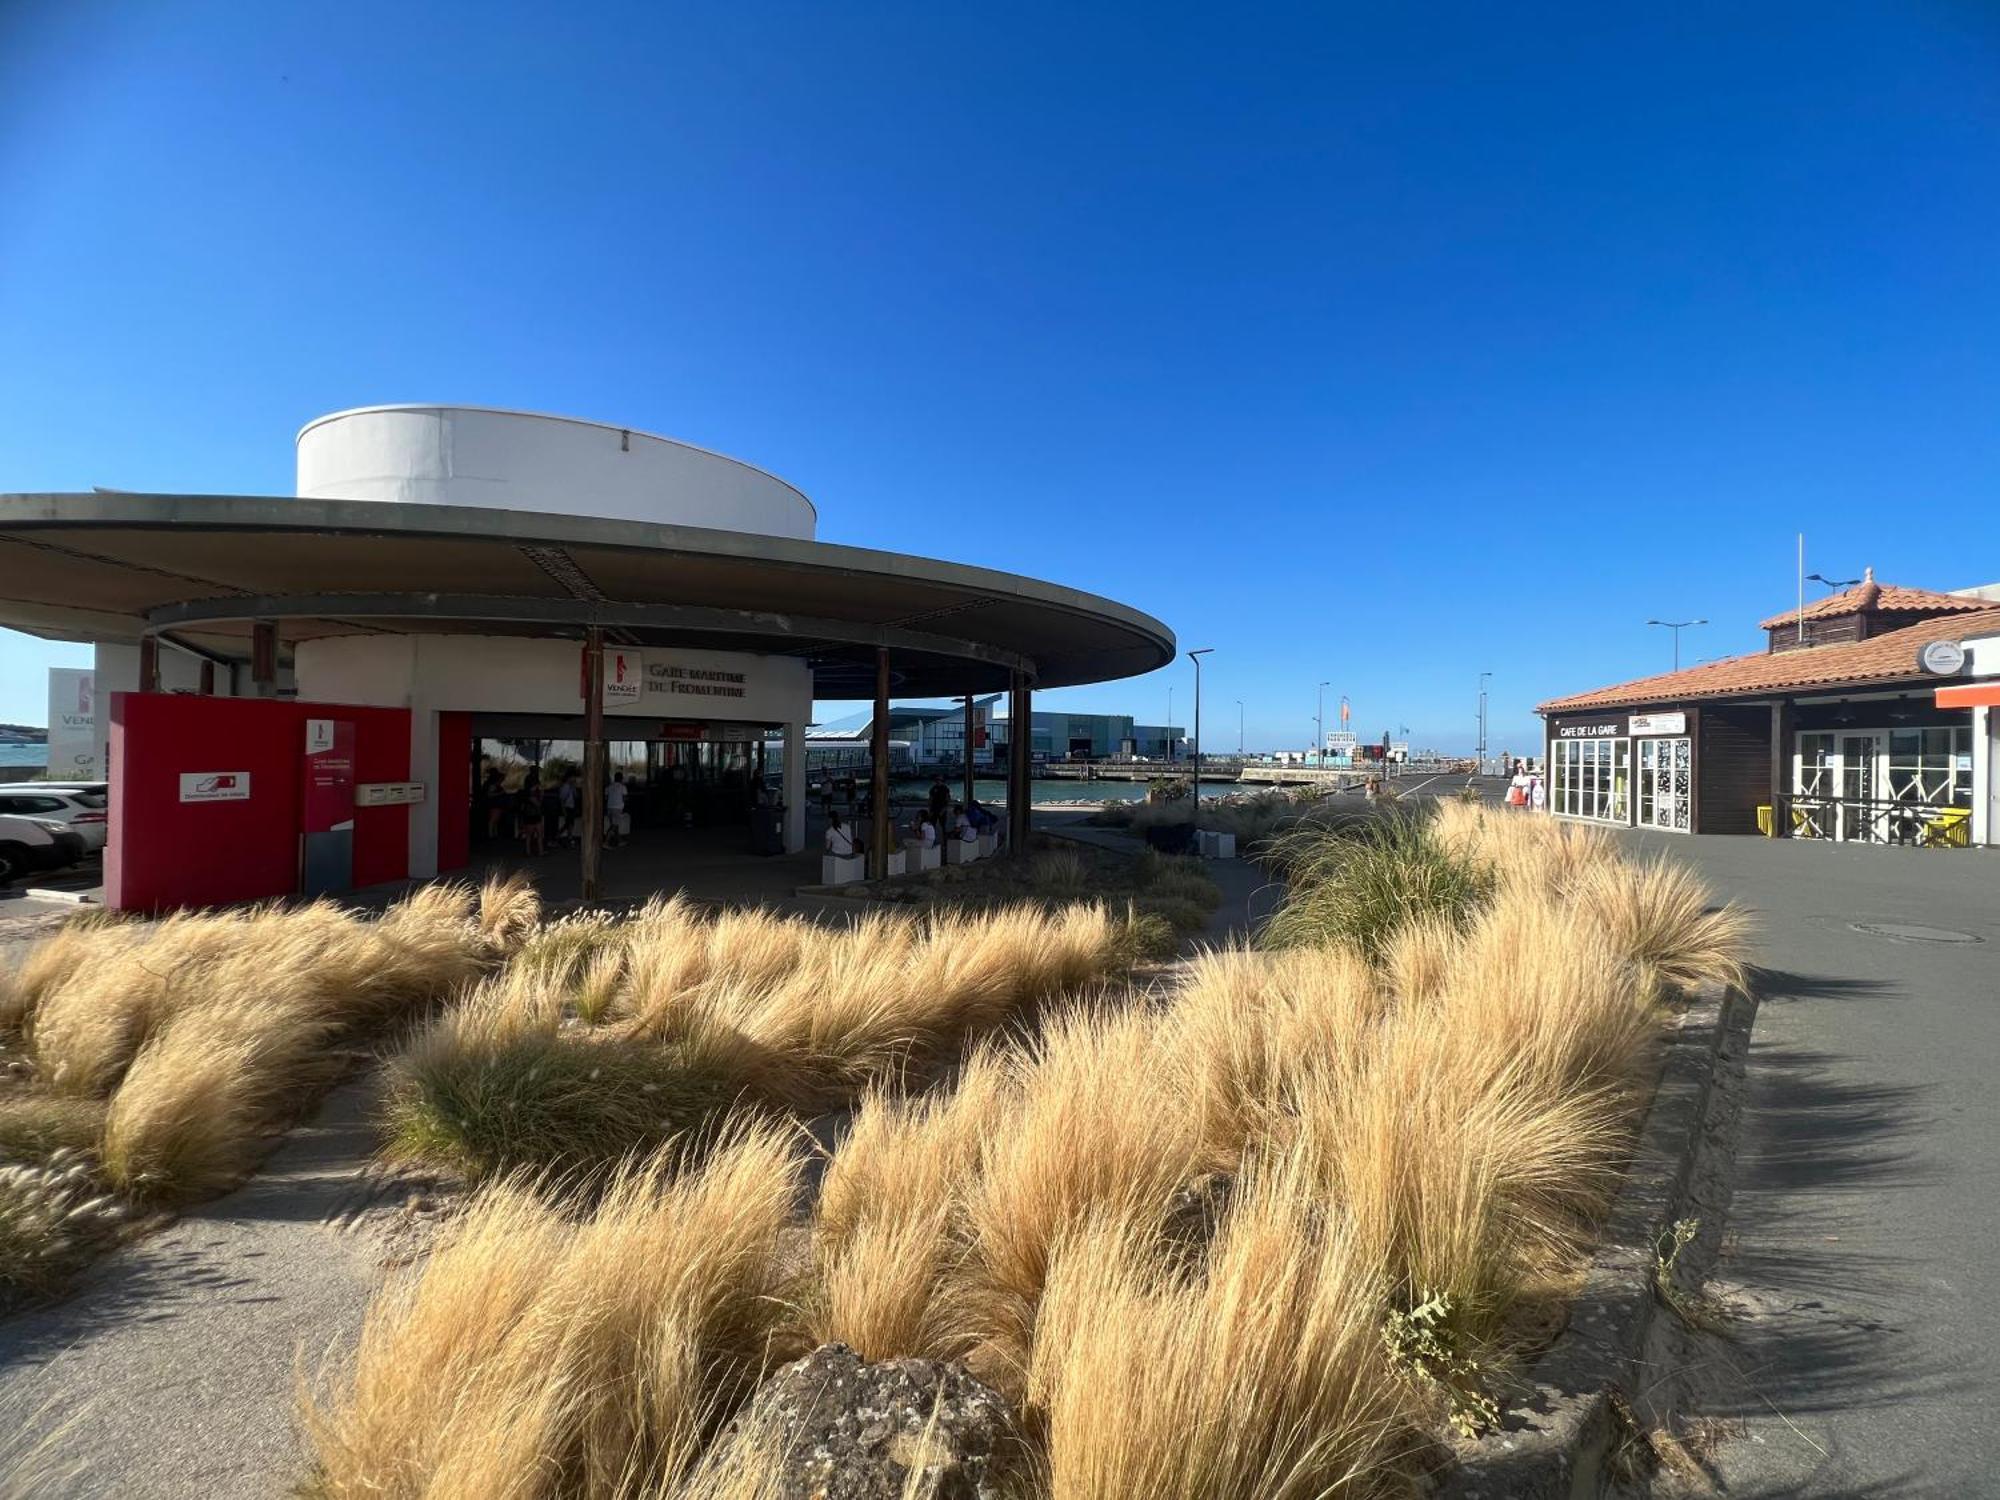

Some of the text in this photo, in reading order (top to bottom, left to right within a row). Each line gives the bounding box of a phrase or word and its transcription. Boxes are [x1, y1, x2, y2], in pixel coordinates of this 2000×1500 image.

[1577, 726, 1587, 736] DE
[1588, 726, 1597, 736] LA
[1598, 724, 1618, 736] GARE
